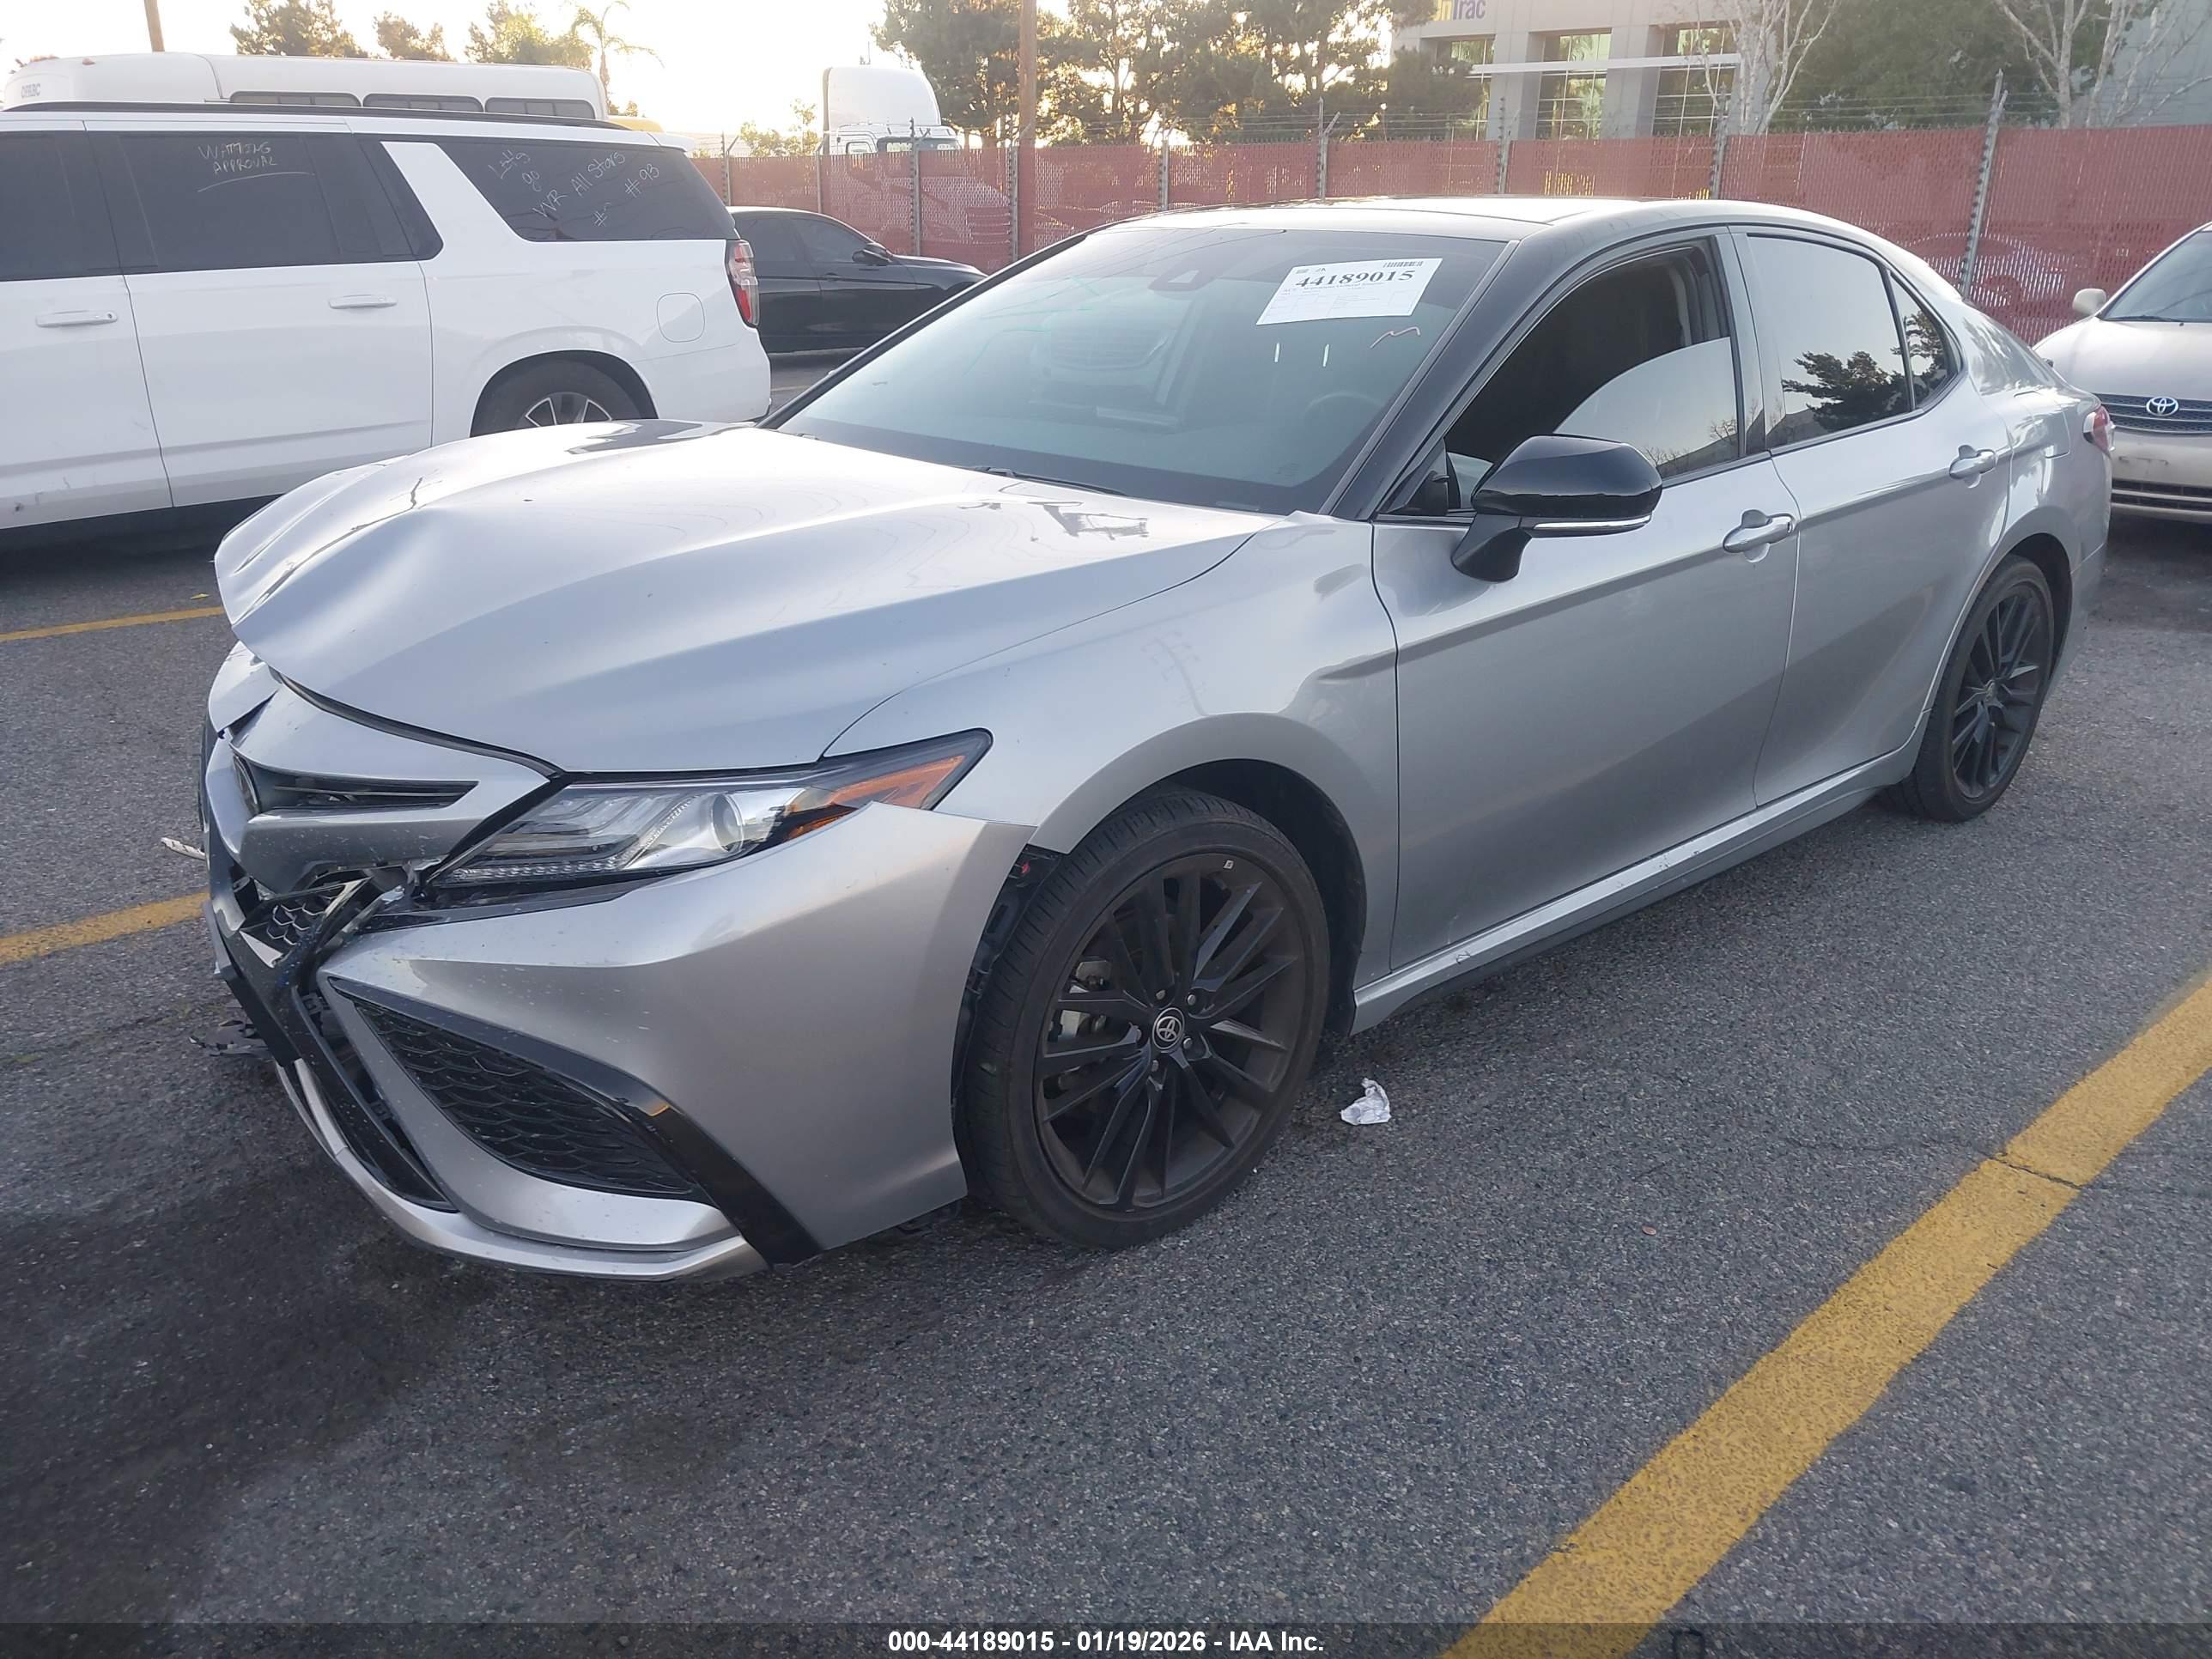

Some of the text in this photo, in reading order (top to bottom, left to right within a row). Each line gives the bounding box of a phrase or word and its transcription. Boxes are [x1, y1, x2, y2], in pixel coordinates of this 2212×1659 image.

[571, 172, 593, 197] All
[587, 151, 626, 179] Stars
[1295, 270, 1416, 288] 44189015
